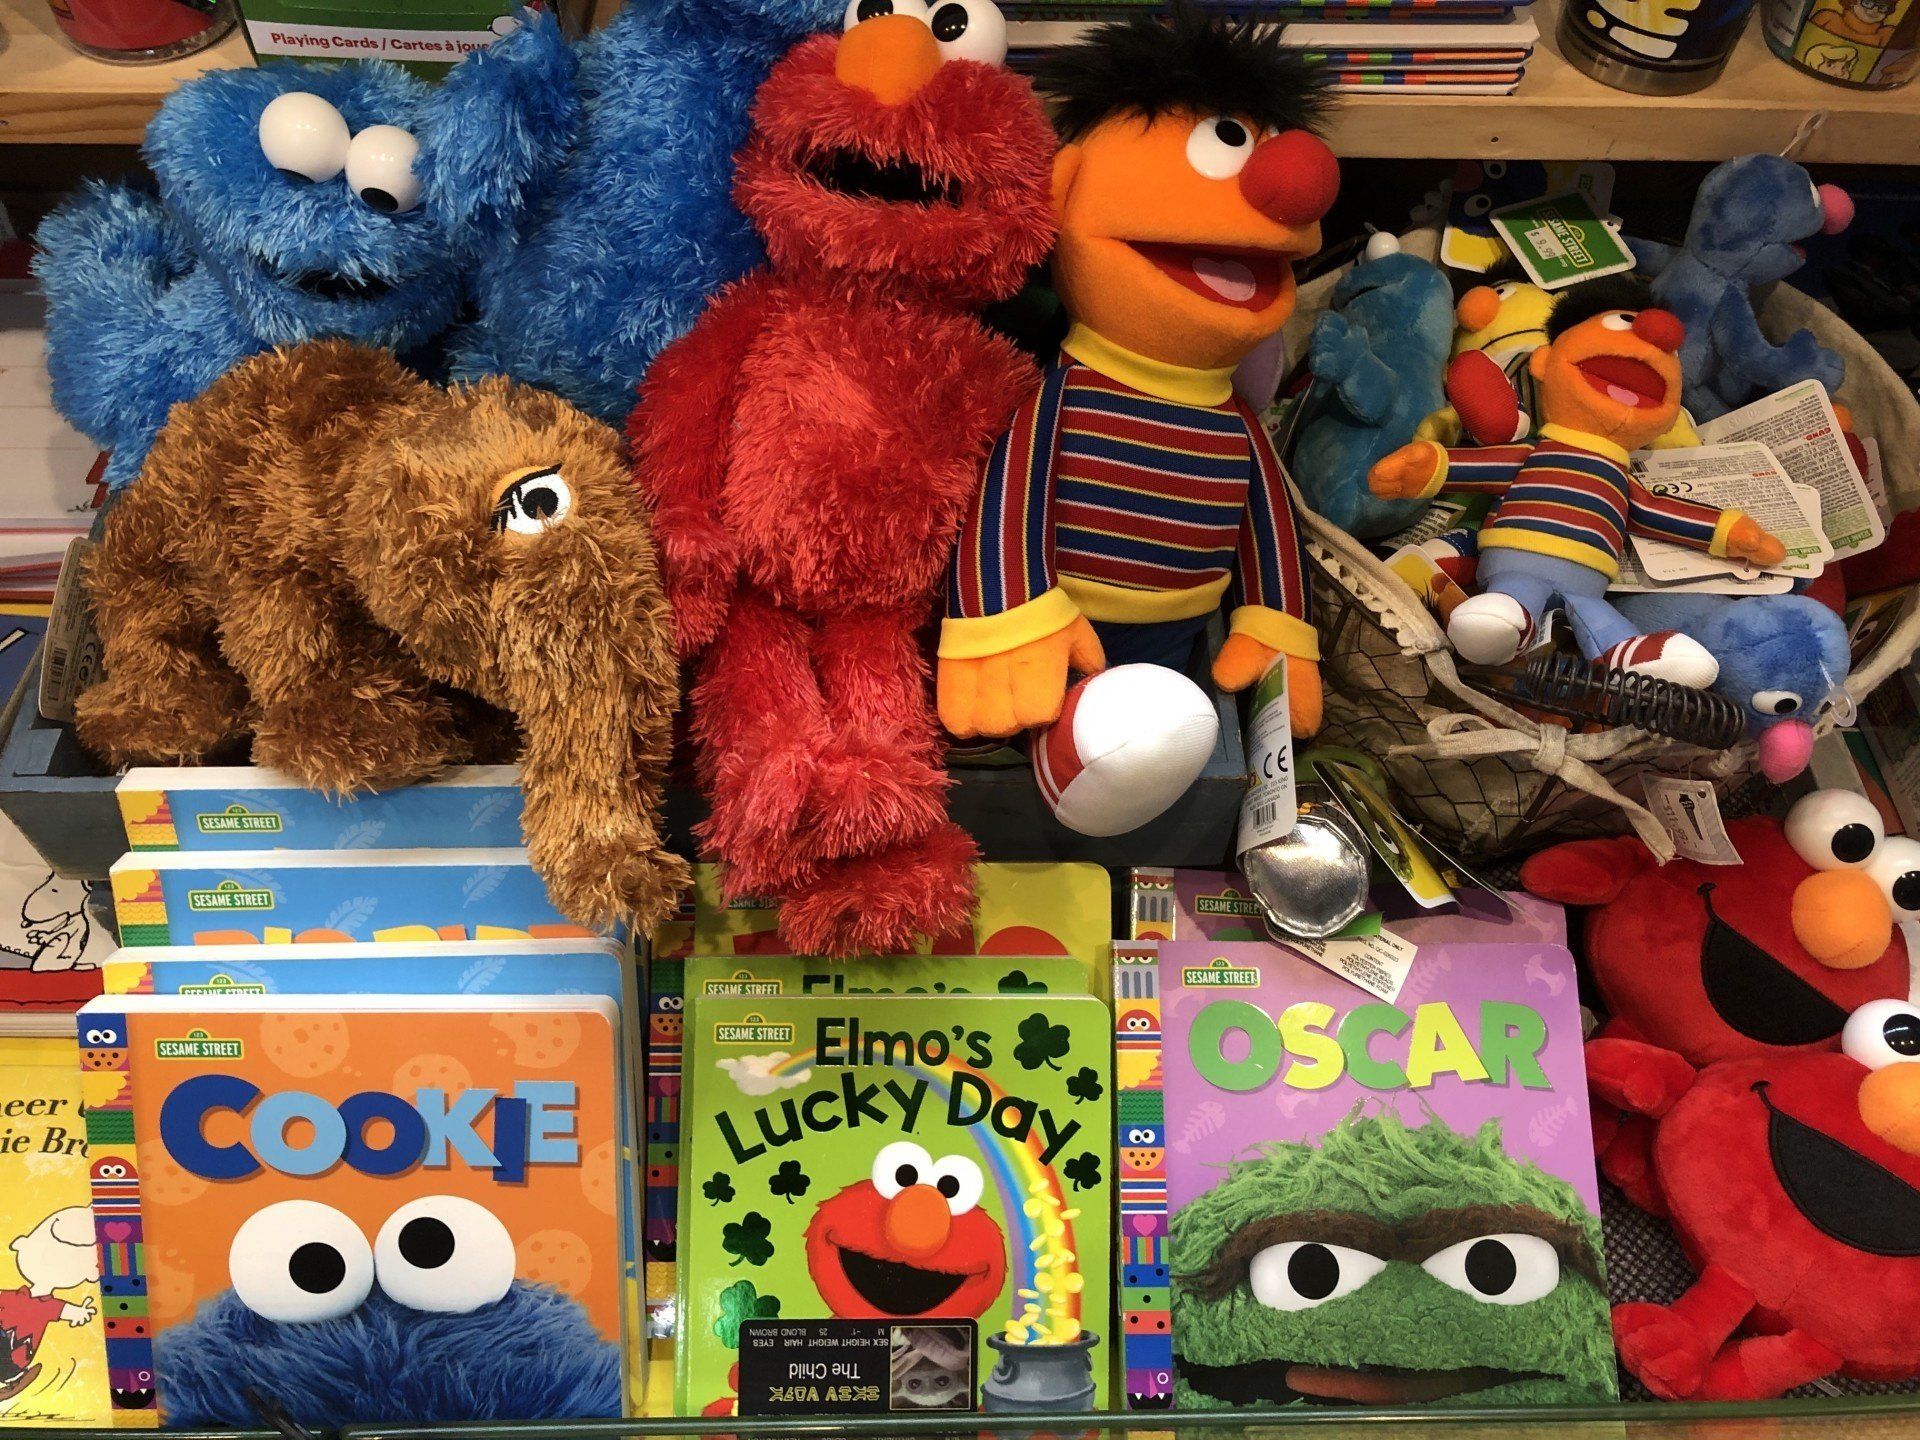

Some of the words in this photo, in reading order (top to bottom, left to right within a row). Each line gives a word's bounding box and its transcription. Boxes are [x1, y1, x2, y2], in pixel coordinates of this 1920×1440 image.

[271, 32, 330, 48] Playing
[332, 37, 379, 49] Cards
[381, 37, 387, 50] /
[391, 38, 442, 52] Cartes
[445, 40, 454, 51] à
[1562, 235, 1588, 263] STREET
[202, 817, 241, 829] SESAME
[243, 817, 277, 829] STREET
[193, 894, 232, 907] SESAME
[234, 894, 269, 906] STREET
[1200, 900, 1231, 912] SESAME
[1186, 971, 1221, 984] SESAME
[1223, 971, 1255, 984] STREET
[707, 984, 743, 995] SESAME
[745, 984, 778, 995] STREET
[719, 1027, 755, 1040] SESAME
[757, 1027, 791, 1040] STREET
[160, 1043, 200, 1056] SESAME
[202, 1043, 239, 1056] STREET
[815, 1017, 993, 1069] Elmo's
[1189, 1001, 1555, 1092] OSCAR
[714, 1071, 930, 1166] Lucky
[946, 1070, 1082, 1167] Day
[160, 1074, 578, 1183] COOKIE
[752, 1338, 773, 1346] EYES
[783, 1338, 802, 1346] HAIR
[788, 1362, 827, 1379] Child
[831, 1362, 860, 1378] The
